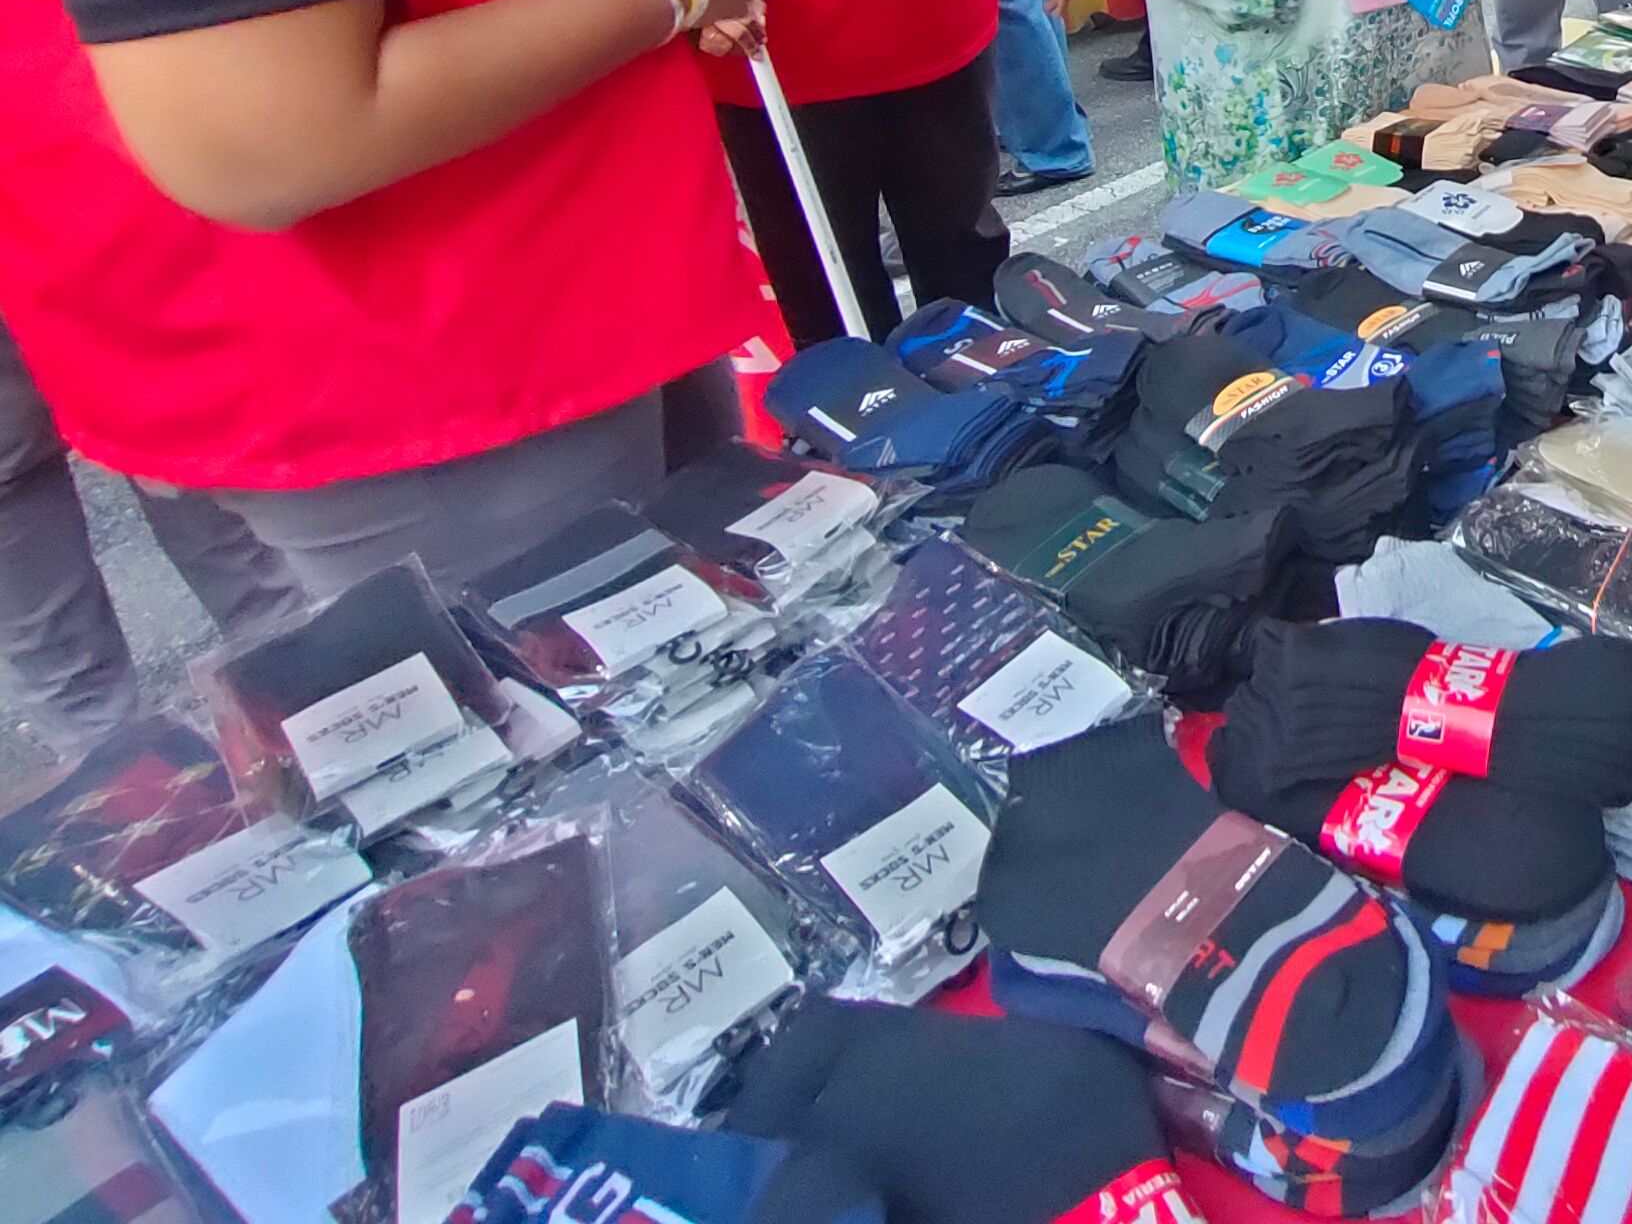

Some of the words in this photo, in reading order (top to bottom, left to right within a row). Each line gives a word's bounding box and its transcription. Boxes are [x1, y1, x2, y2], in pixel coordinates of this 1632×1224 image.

[1323, 350, 1357, 379] STAR
[1240, 384, 1290, 420] FASHION
[1054, 517, 1120, 569] STAR
[1026, 677, 1076, 717] MR
[338, 703, 401, 744] MR
[911, 820, 956, 856] MEN'S
[858, 855, 910, 892] SOCKS
[892, 844, 950, 892] MR
[683, 930, 736, 970] MEN'S
[622, 971, 681, 1017] SOCKS
[657, 956, 724, 1013] MR
